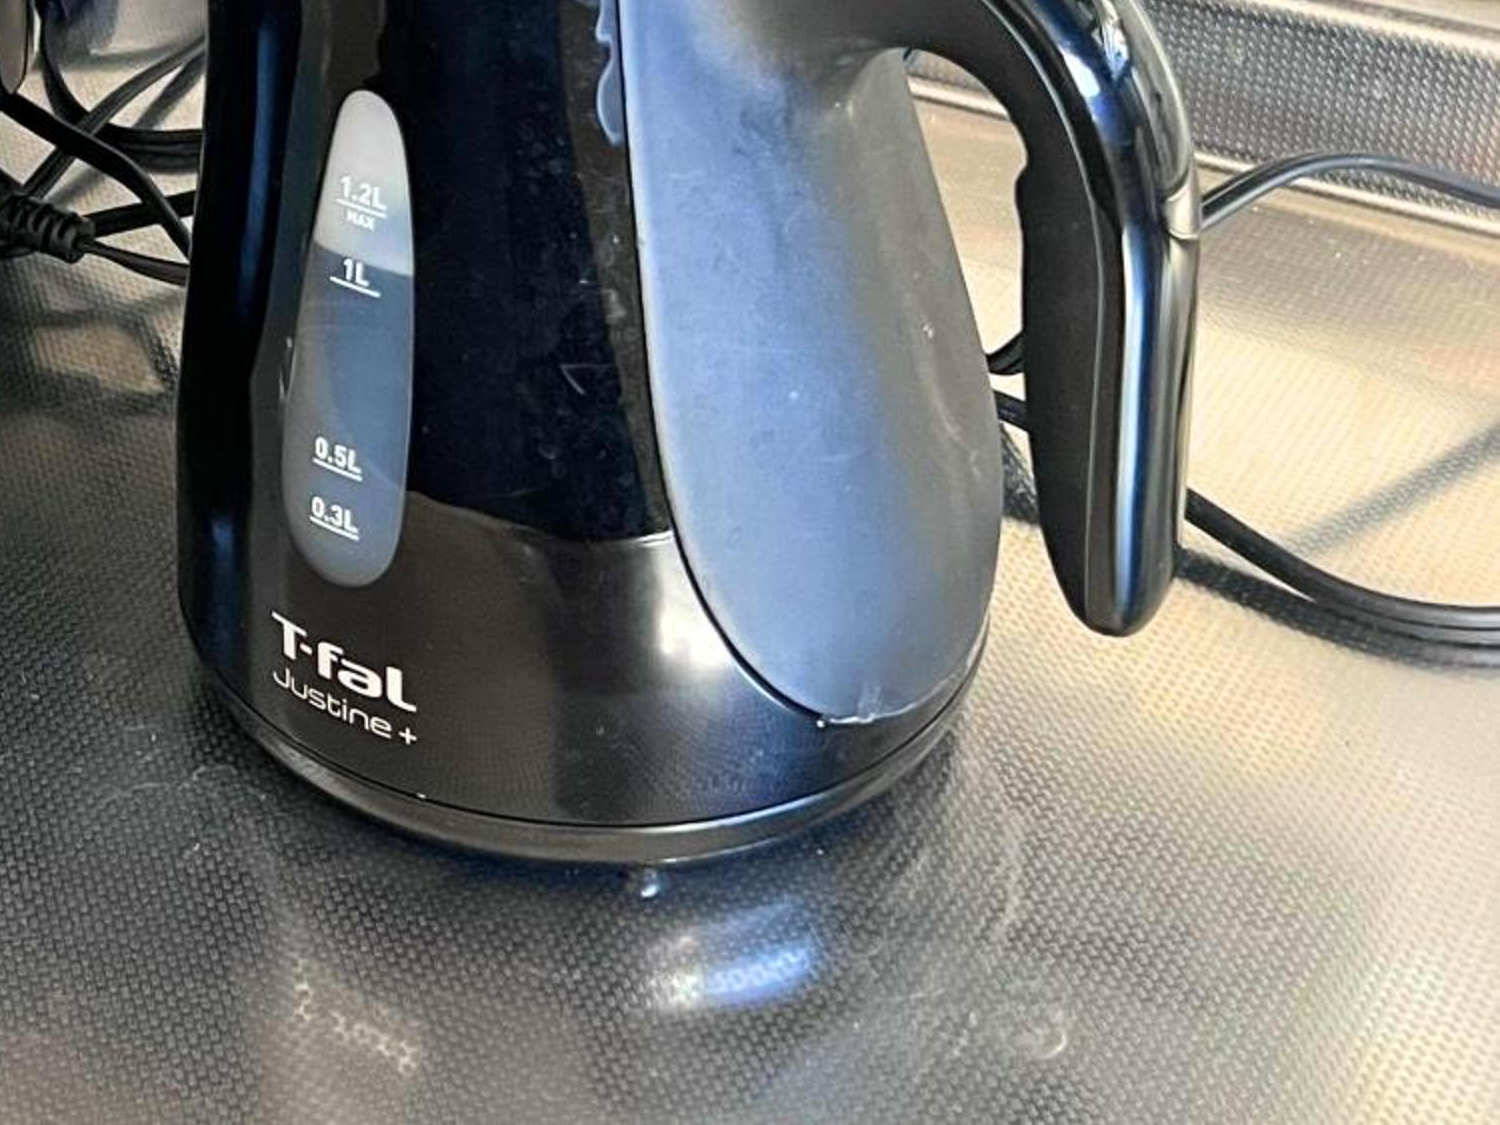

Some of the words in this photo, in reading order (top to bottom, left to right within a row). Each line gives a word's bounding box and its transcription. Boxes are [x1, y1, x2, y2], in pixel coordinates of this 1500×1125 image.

[340, 176, 387, 211] 1.2L
[345, 209, 376, 231] MAX
[341, 257, 370, 287] 1L
[314, 435, 363, 474] 0.5L
[310, 496, 360, 533] 0.3L
[270, 610, 418, 713] T-fal
[272, 667, 393, 741] Justine
